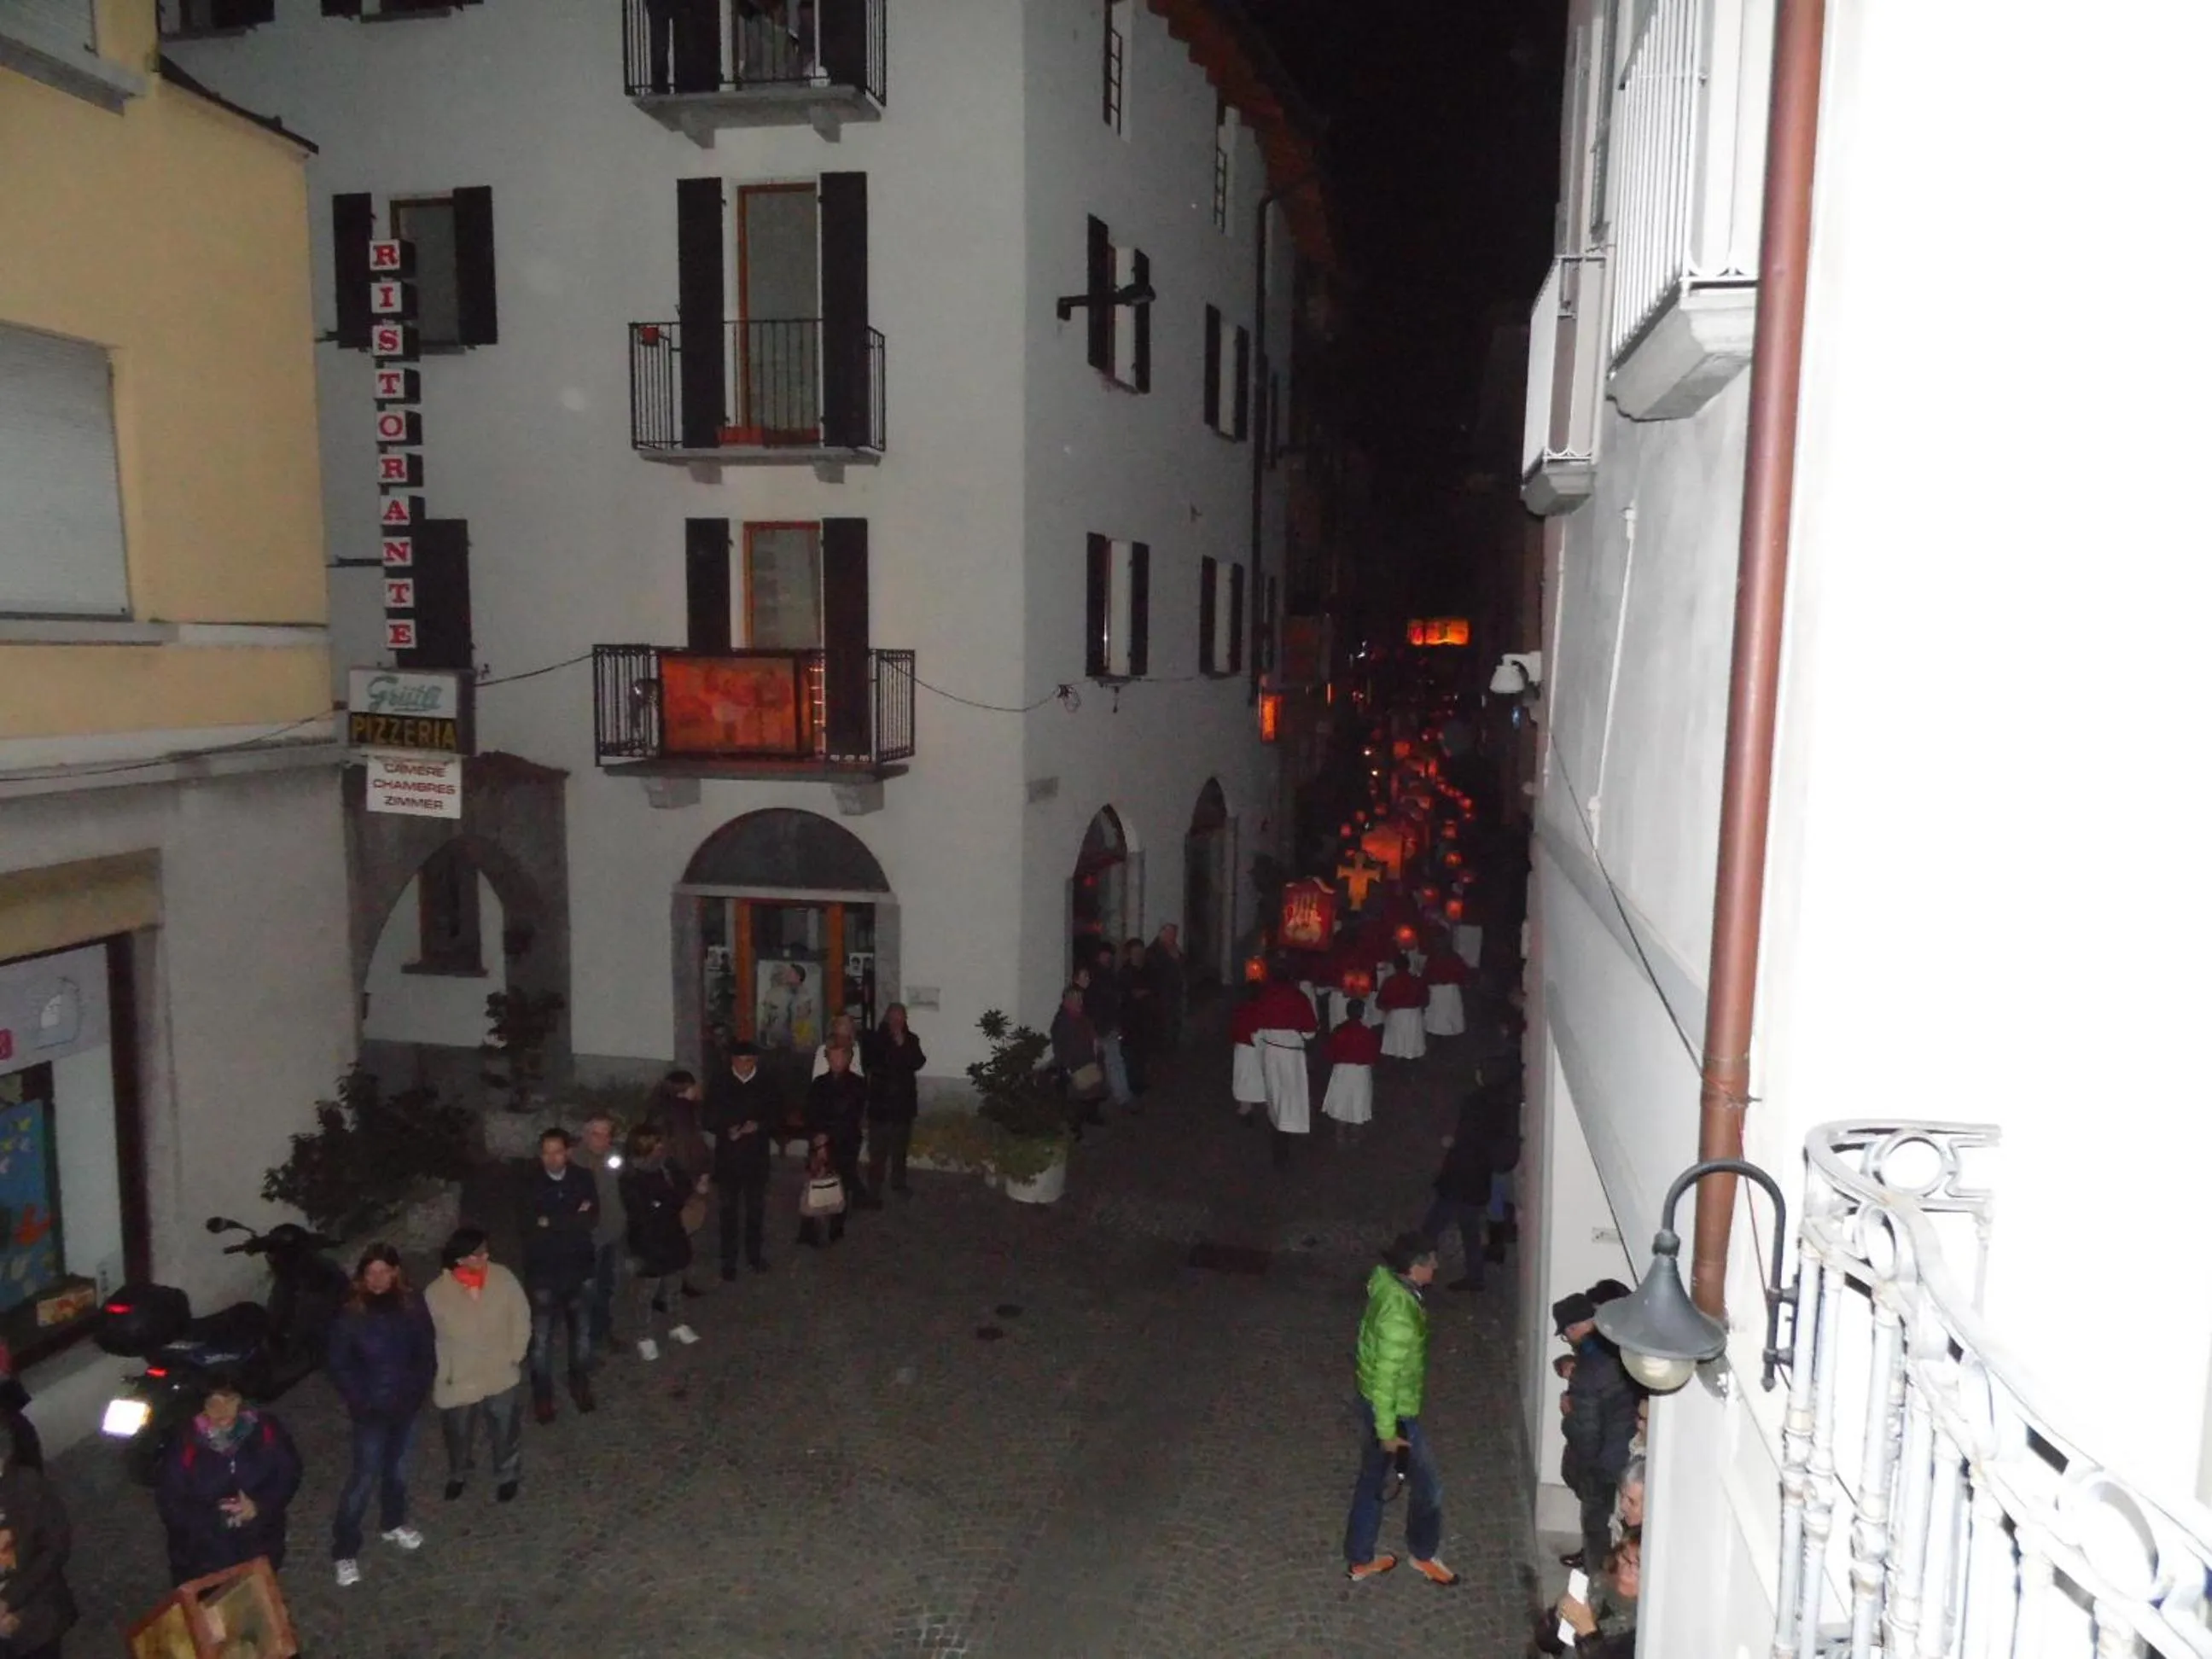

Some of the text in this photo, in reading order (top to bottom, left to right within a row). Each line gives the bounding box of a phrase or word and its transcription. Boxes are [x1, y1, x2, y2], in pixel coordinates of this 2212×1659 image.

[373, 244, 411, 645] RISTORANTE
[352, 715, 456, 749] PIZZERIA
[385, 762, 446, 777] CAMERE
[373, 778, 456, 795] CHAMBRES
[384, 795, 444, 810] ZIMMER
